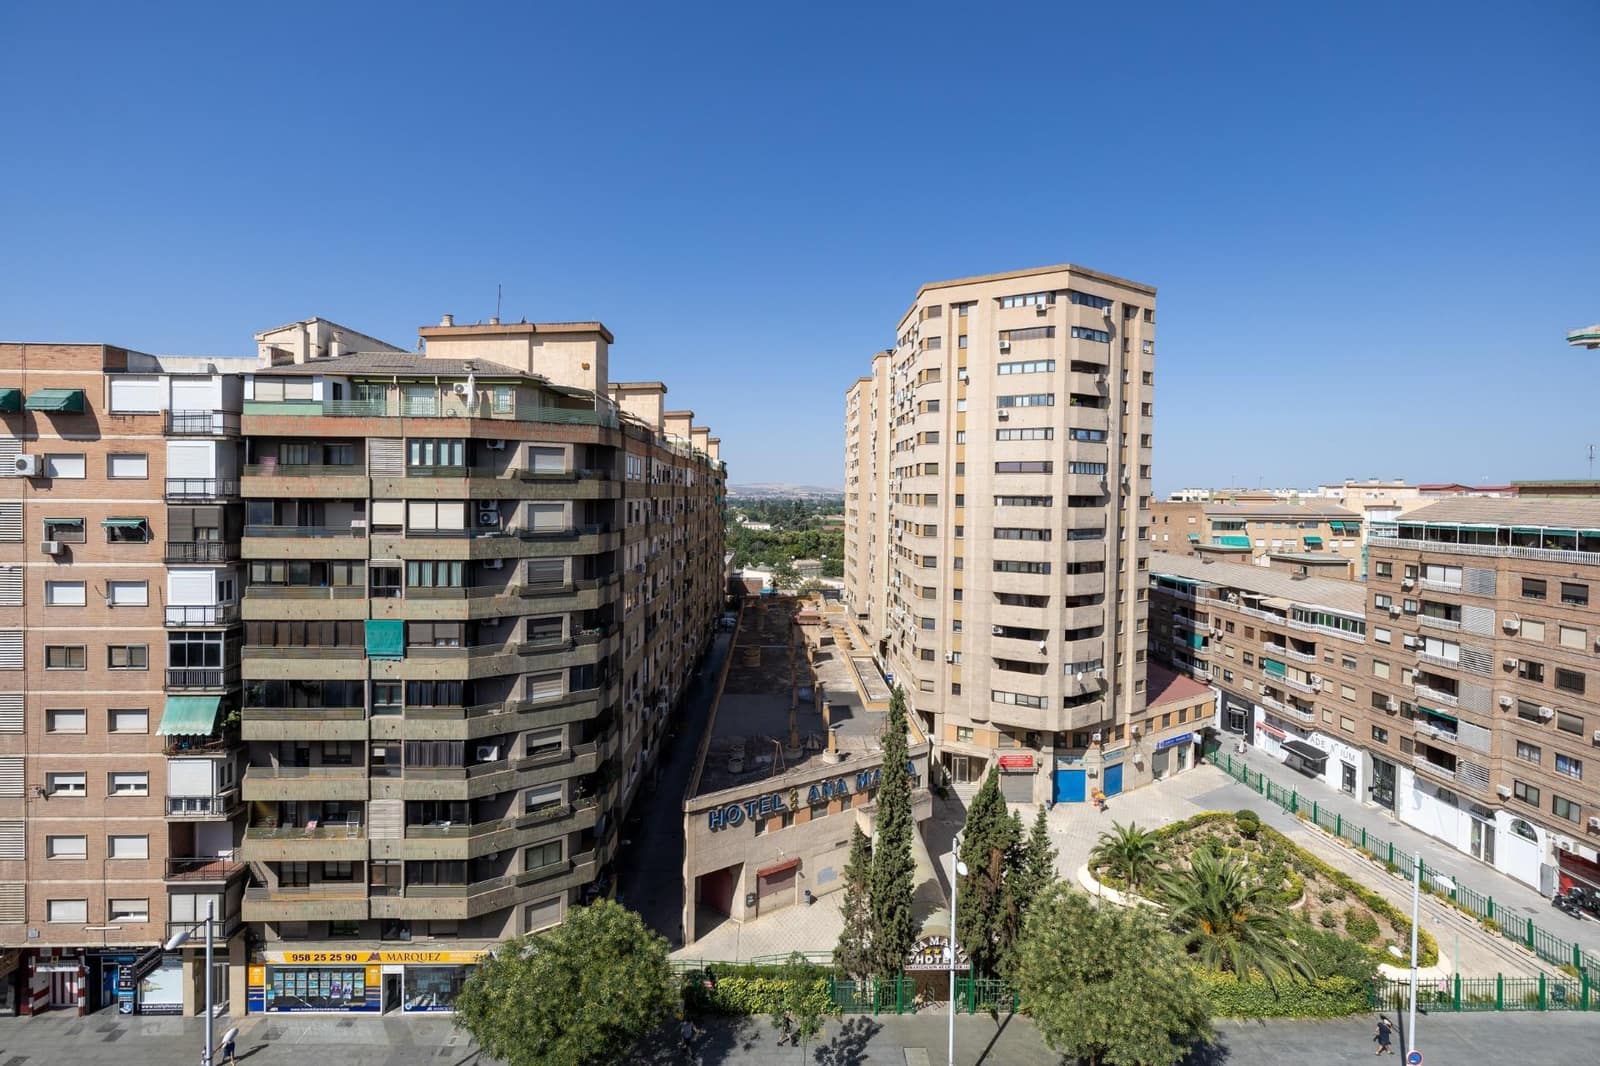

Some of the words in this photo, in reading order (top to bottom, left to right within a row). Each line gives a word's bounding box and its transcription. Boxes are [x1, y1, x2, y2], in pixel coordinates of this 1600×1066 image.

[708, 794, 786, 830] HOTEL
[807, 778, 849, 804] ANA
[856, 761, 917, 791] MAA
[292, 953, 311, 962] 958
[314, 953, 327, 962] 25
[329, 953, 343, 962] 25
[345, 953, 358, 962] 90
[386, 952, 441, 963] MARQUEZ
[915, 955, 958, 964] HOTE
